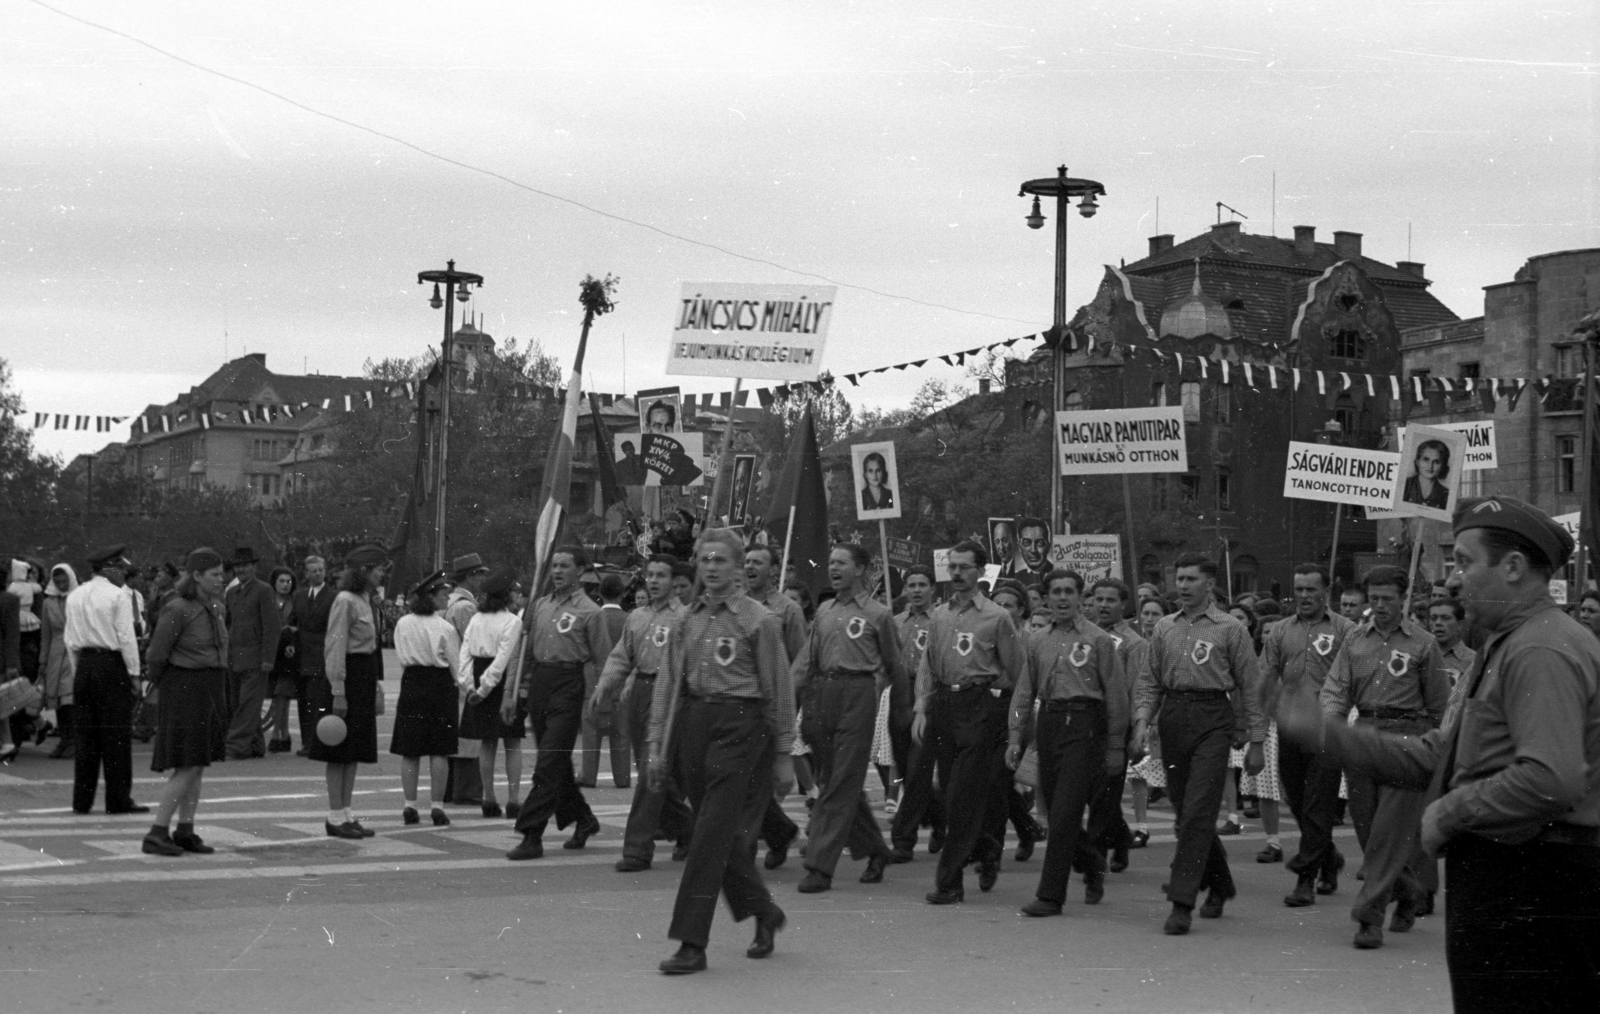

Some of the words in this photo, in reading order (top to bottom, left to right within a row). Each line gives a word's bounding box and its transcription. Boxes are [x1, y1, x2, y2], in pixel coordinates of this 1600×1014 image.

[1060, 421, 1113, 444] MAGYAR
[1114, 418, 1181, 443] PAMUTIPAR
[653, 437, 678, 450] MKP
[644, 456, 675, 476] KÖRZET
[1129, 449, 1180, 463] OTTHON
[1290, 478, 1391, 499] TANONCOTTHON
